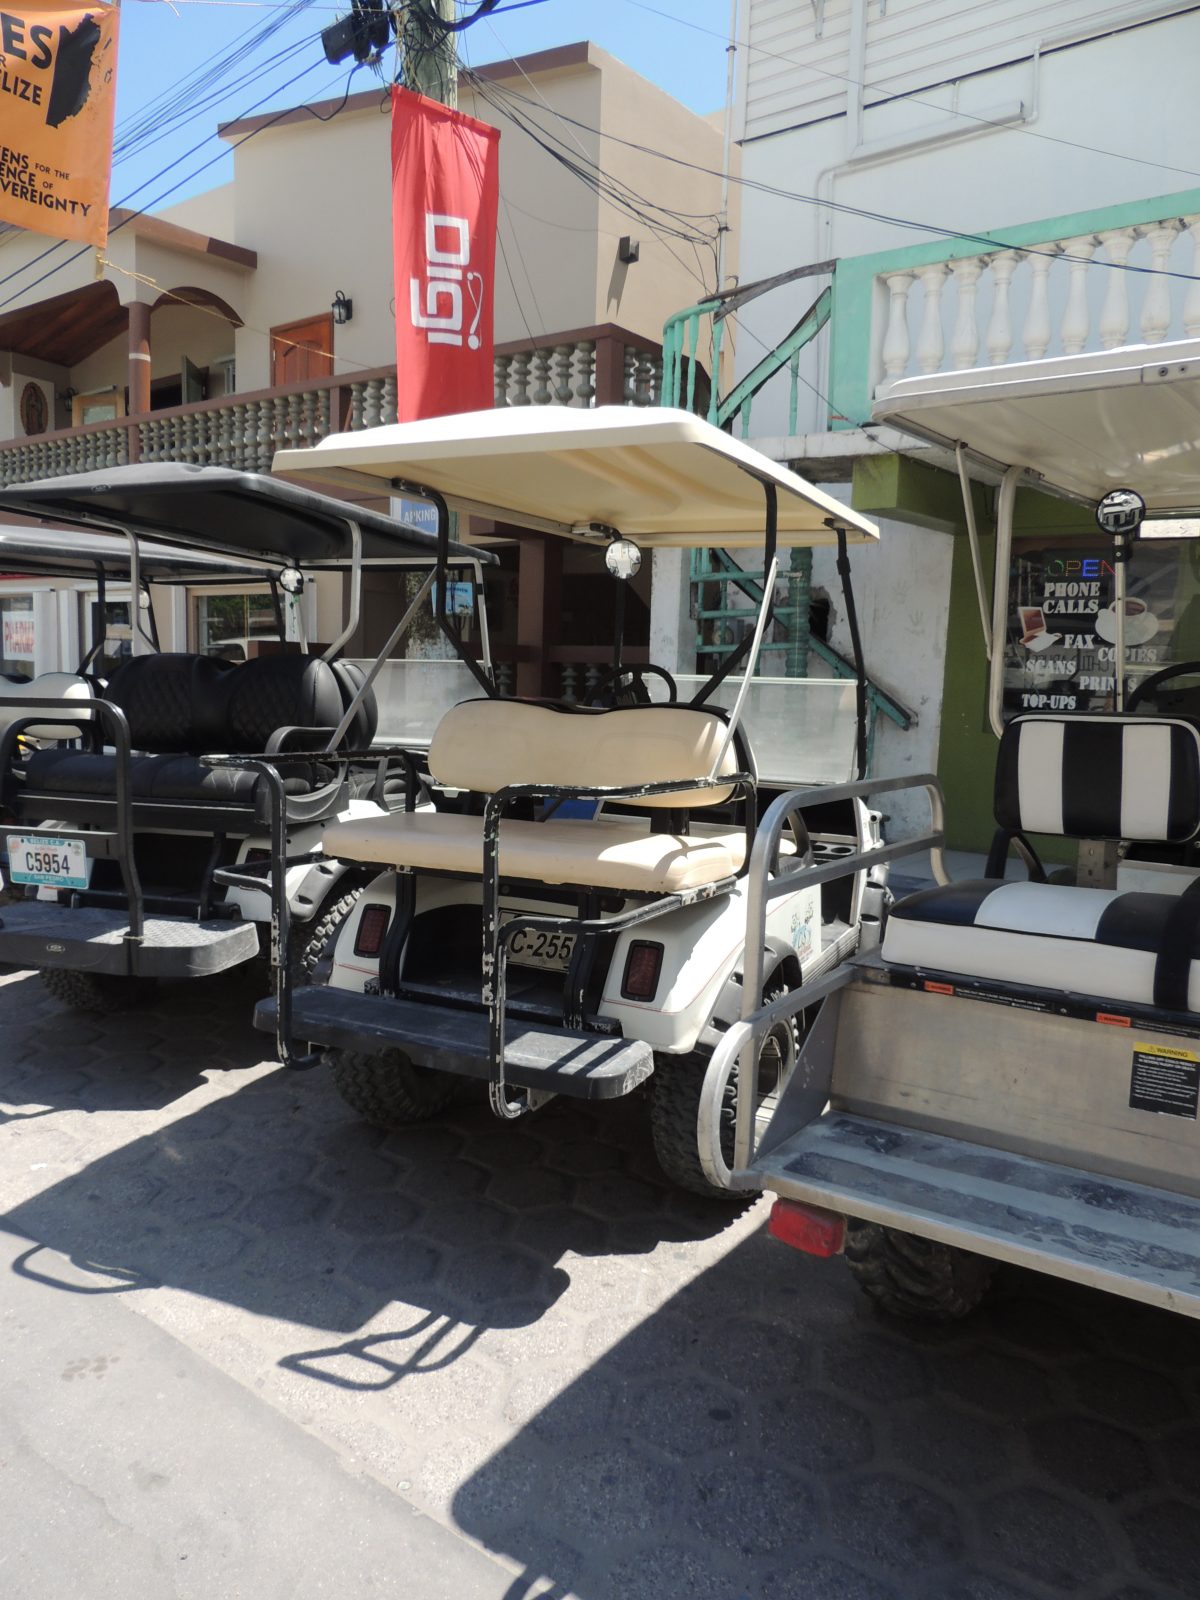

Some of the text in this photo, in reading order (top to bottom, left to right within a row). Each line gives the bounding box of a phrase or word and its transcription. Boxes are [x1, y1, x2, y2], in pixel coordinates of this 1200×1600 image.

[0, 12, 53, 70] ES
[0, 69, 43, 106] LIZE
[0, 145, 70, 181] ENS FOR THE
[42, 181, 54, 190] OF
[1047, 559, 1117, 577] OPEN
[1044, 581, 1100, 598] PHONE
[1042, 599, 1099, 614] CALLS
[1063, 634, 1095, 650] FAX
[1026, 659, 1077, 676] SCANS
[1079, 676, 1138, 692] PRINS
[1022, 694, 1077, 710] TOP-UPS
[25, 851, 70, 875] C5954
[510, 929, 573, 960] C-255
[1156, 1047, 1188, 1058] WARNING
